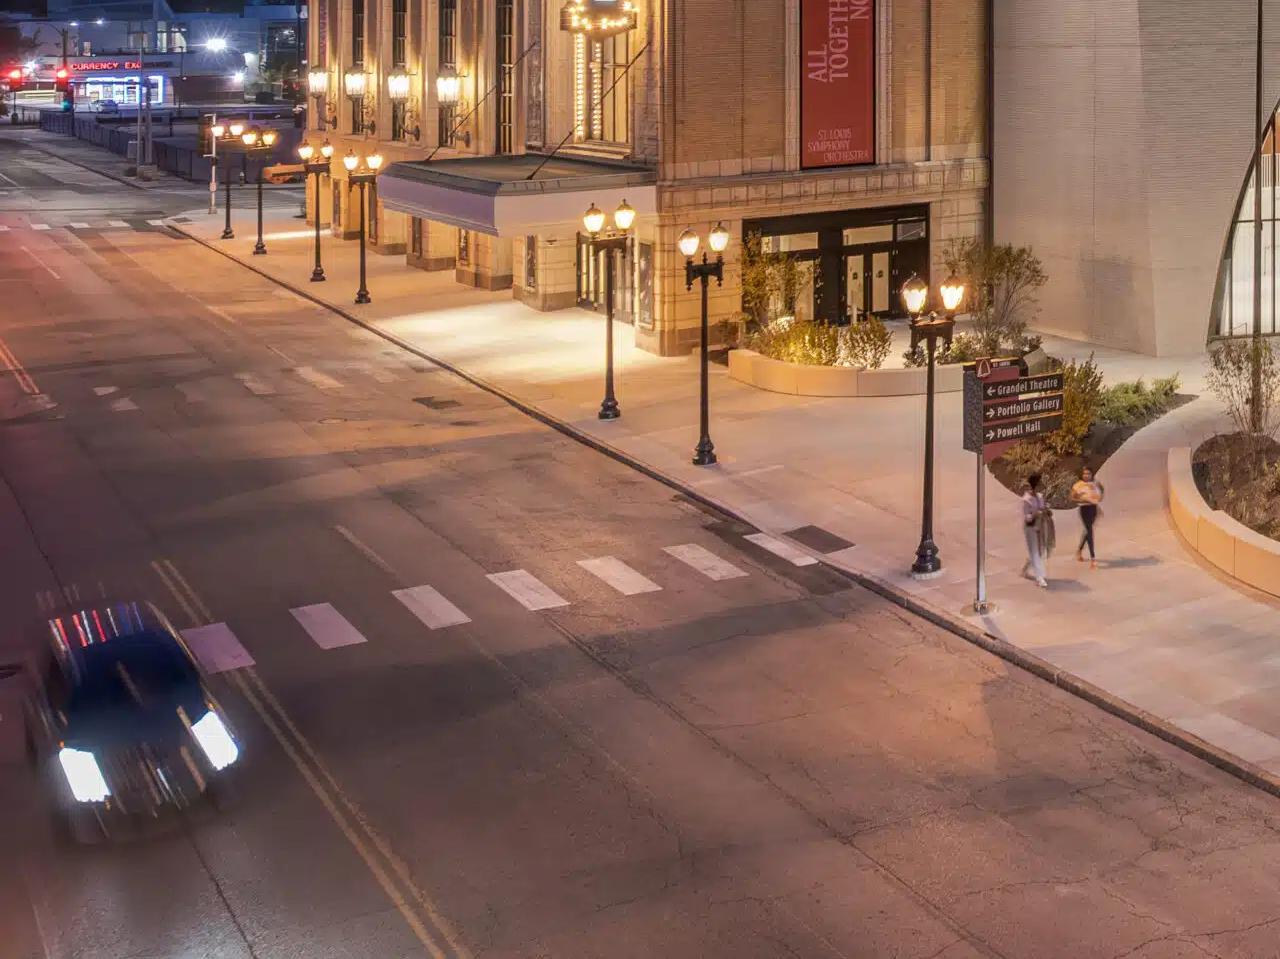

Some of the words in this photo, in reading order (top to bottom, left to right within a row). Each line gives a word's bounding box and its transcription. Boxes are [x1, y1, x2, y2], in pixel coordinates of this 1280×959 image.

[71, 61, 120, 71] CURRENCY
[807, 44, 828, 83] ALL
[807, 140, 851, 152] SYMPHONY
[997, 380, 1028, 395] Grandel
[1030, 378, 1058, 391] Theatre
[997, 401, 1031, 417] Portfolio
[1033, 398, 1060, 411] Gallery
[997, 426, 1024, 439] Powell
[1025, 421, 1041, 433] Hall
